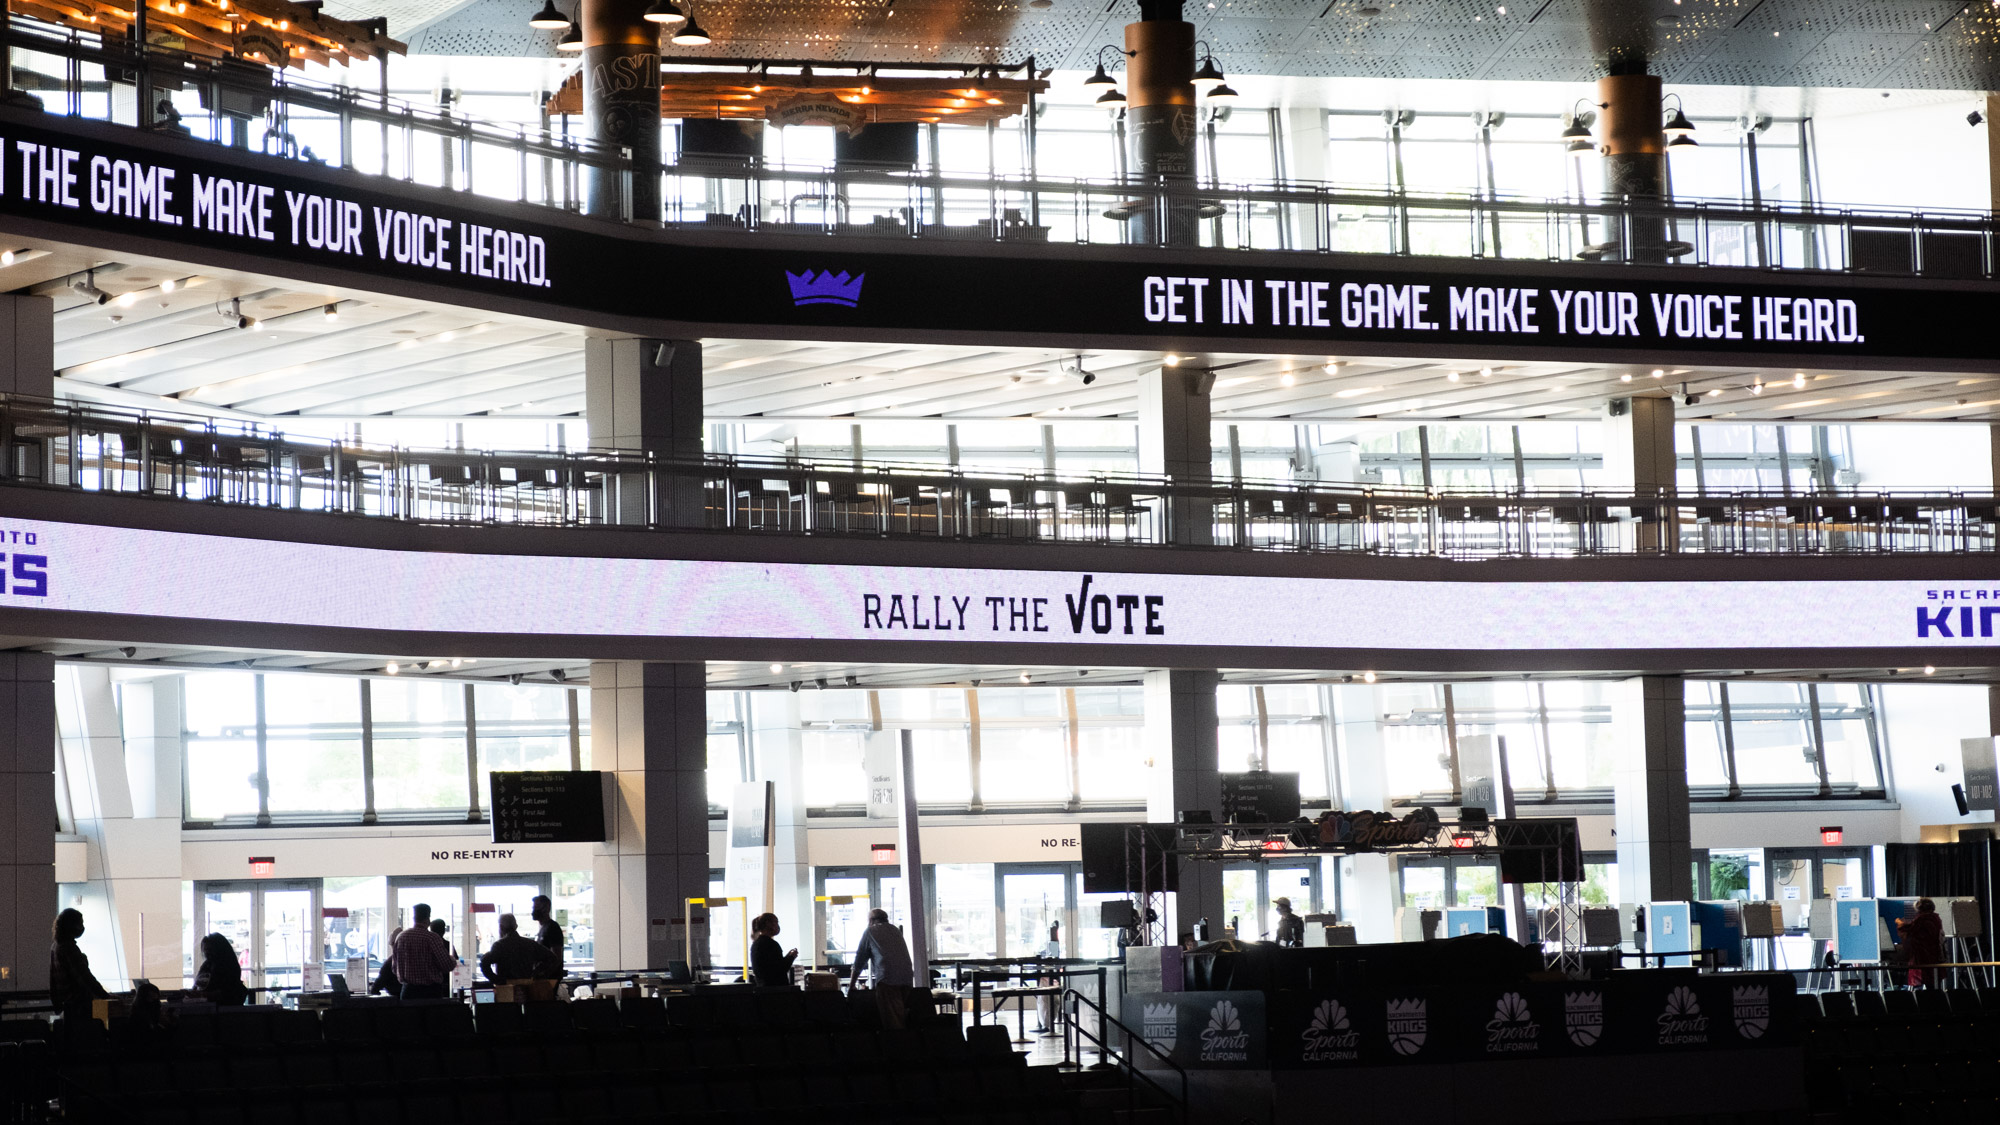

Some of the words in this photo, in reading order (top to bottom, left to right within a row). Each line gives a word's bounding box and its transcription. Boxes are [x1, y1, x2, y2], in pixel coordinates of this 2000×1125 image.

[781, 105, 814, 118] SIERRA
[815, 104, 850, 118] NEVADA
[17, 141, 80, 208] THE
[91, 156, 182, 226] GAME.
[192, 173, 274, 241] MAKE
[285, 190, 363, 256] YOUR
[373, 206, 452, 270] VOICE
[460, 222, 551, 288] HEARD.
[1144, 276, 1209, 323] GET
[1221, 279, 1254, 324] IN
[1266, 280, 1330, 327] THE
[1341, 282, 1440, 330] GAME.
[1450, 286, 1539, 334] MAKE
[1549, 289, 1640, 336] YOUR
[1651, 293, 1742, 339] VOICE
[1752, 296, 1864, 343] HEARD.
[0, 530, 37, 546] TO
[0, 552, 48, 596] S
[863, 594, 970, 630] RALLY
[986, 596, 1048, 632] THE
[1066, 575, 1164, 635] VOTE
[1352, 813, 1420, 848] Sports
[1041, 839, 1057, 847] NO
[1827, 832, 1838, 842] EXIT
[432, 851, 449, 860] NO
[454, 850, 514, 860] RE-ENTRY
[878, 851, 890, 860] EXIT
[256, 864, 269, 874] EXIT
[1734, 1006, 1769, 1018] KINGS
[1566, 1013, 1603, 1025] KINGS
[1657, 1012, 1710, 1038] Sports
[1144, 1025, 1176, 1037] KINGS
[1388, 1020, 1426, 1033] KINGS
[1486, 1019, 1540, 1044] Sports
[1200, 1025, 1249, 1051] Sports
[1301, 1026, 1360, 1051] Sports
[1658, 1035, 1708, 1045] CALIFORNIA
[1486, 1042, 1538, 1052] CALIFORNIA
[1200, 1052, 1247, 1062] CALIFORNIA
[1302, 1050, 1358, 1062] CALIFORNIA
